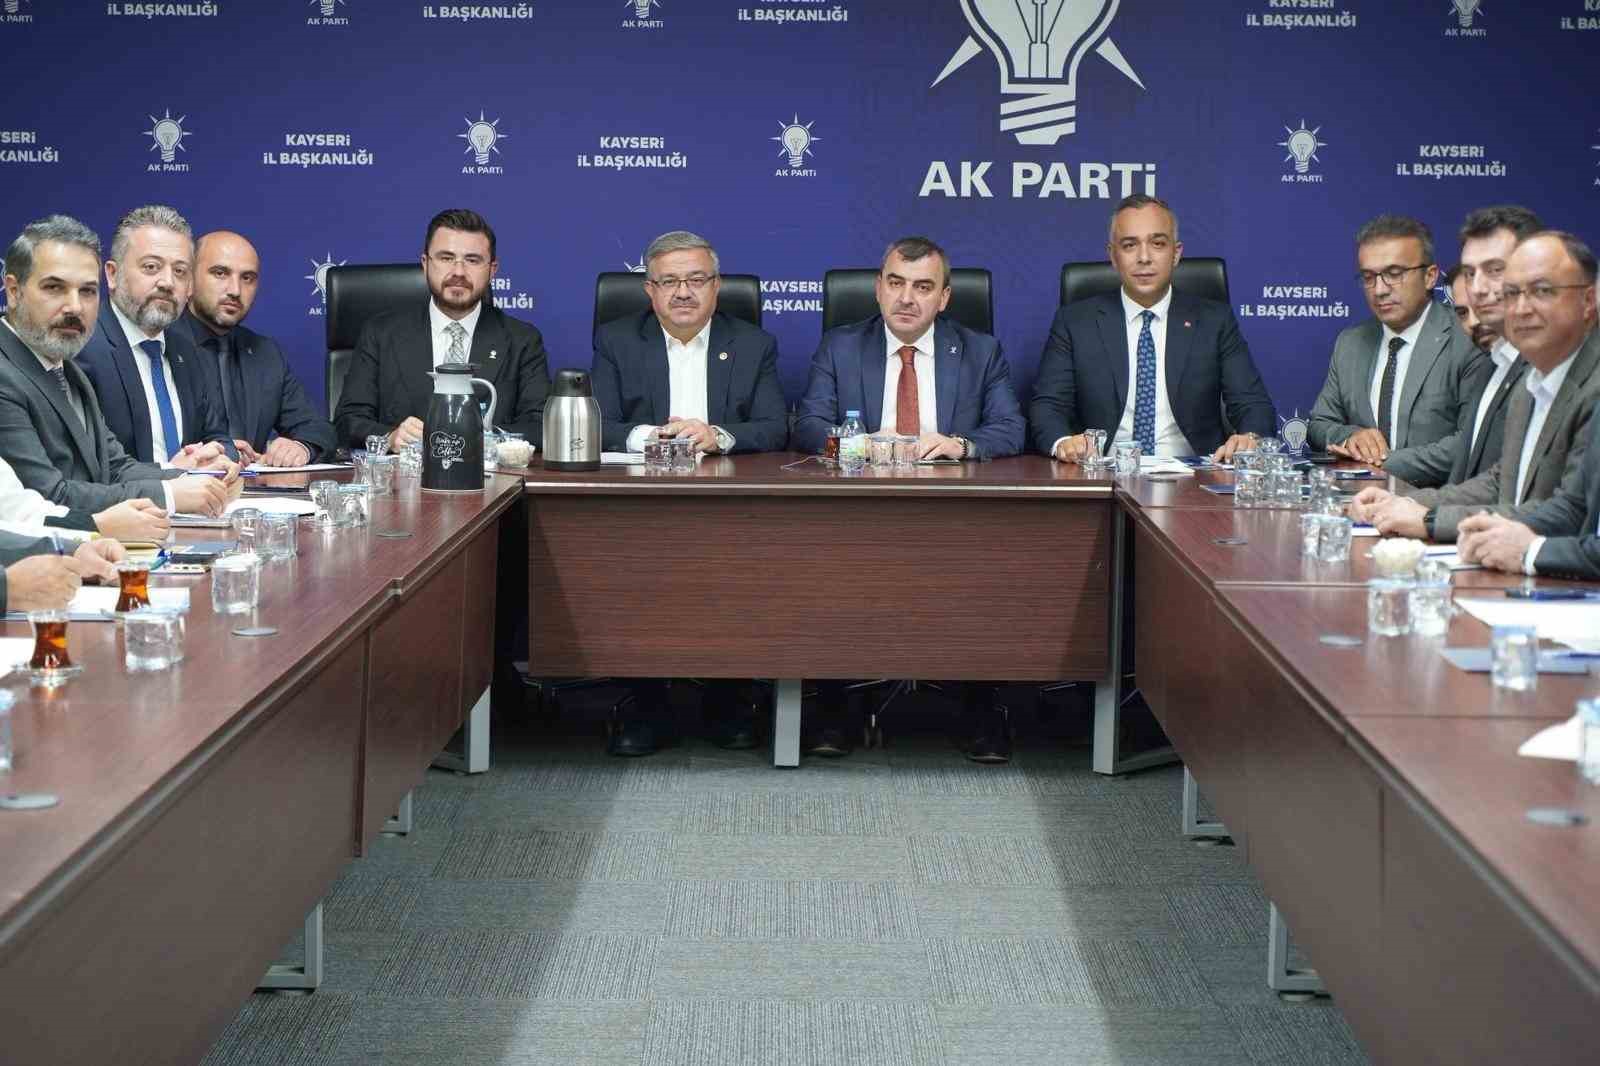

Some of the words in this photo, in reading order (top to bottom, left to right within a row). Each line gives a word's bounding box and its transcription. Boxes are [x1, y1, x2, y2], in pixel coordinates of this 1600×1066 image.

[124, 1, 218, 19] BAŞKANLIĞI
[439, 3, 533, 21] BAŞKANLIĞI
[754, 6, 848, 24] BAŞKANLIĞI
[1262, 11, 1357, 29] BAŞKANLIĞI
[279, 149, 374, 168] BAŞKANLIĞI
[593, 152, 687, 170] BAŞKANLIĞI
[919, 161, 993, 197] AK
[1413, 161, 1506, 179] BAŞKANLIĞI
[1256, 302, 1349, 320] BAŞKANLIĞI
